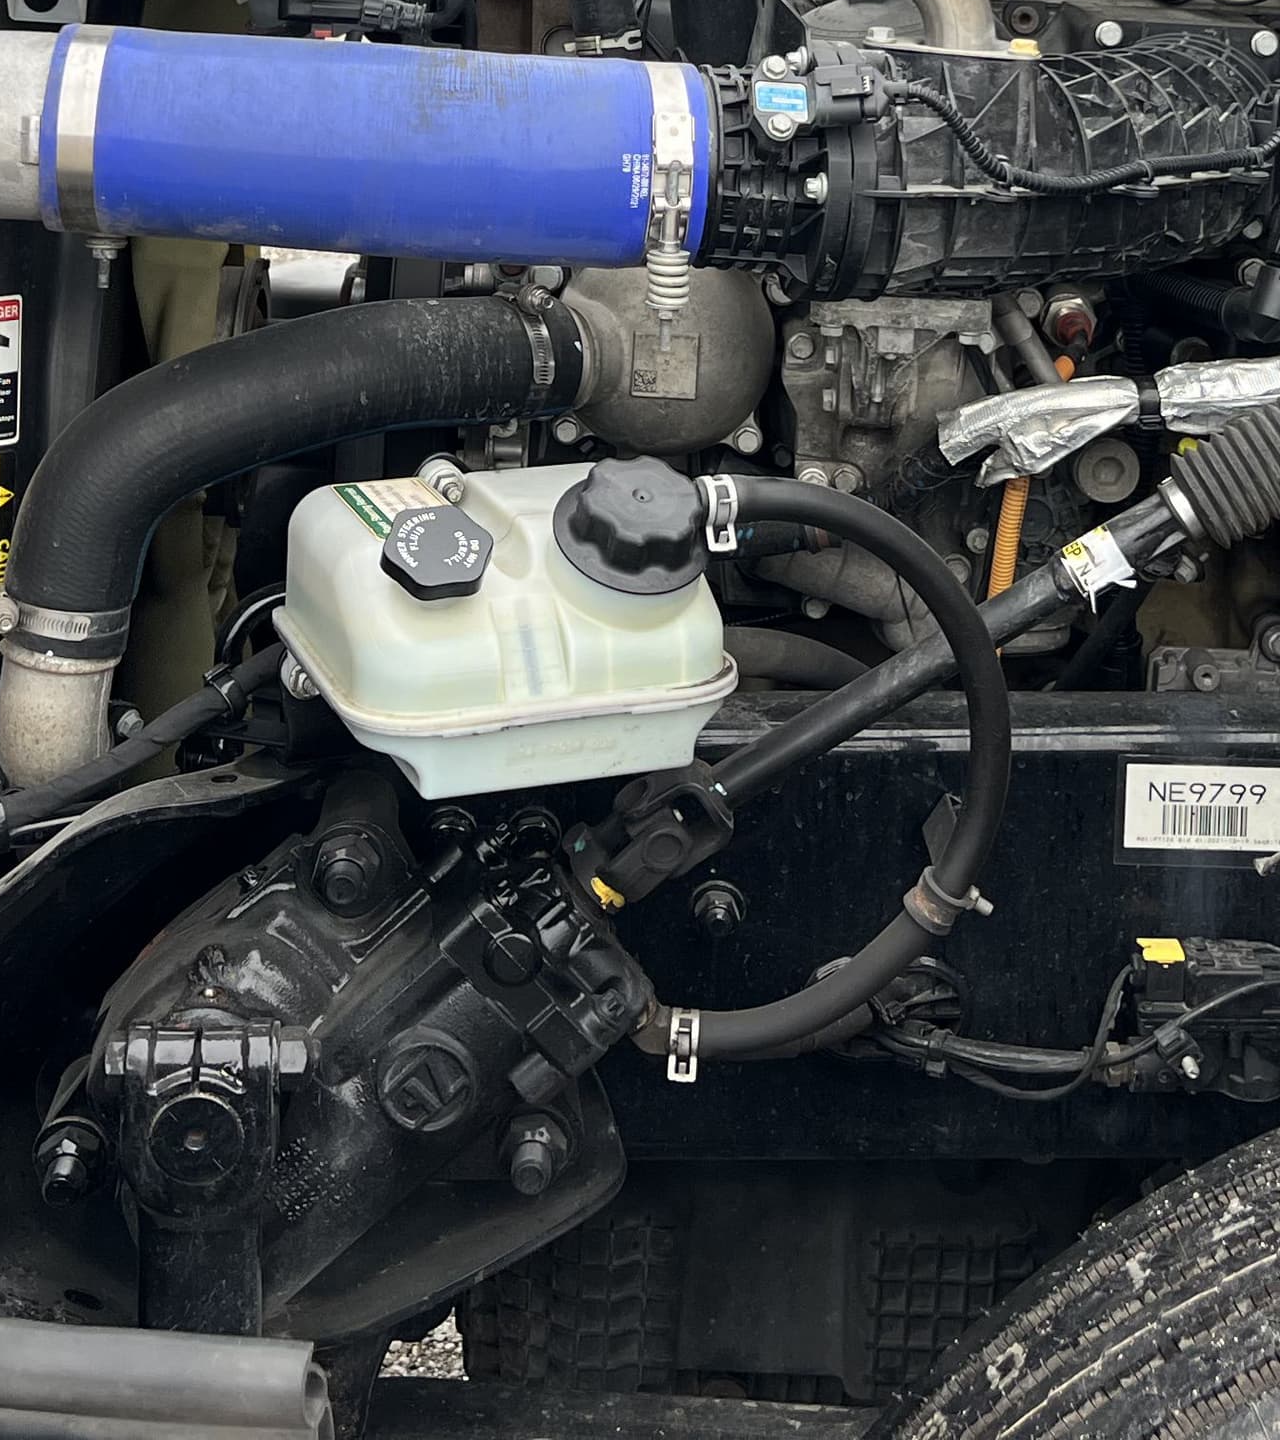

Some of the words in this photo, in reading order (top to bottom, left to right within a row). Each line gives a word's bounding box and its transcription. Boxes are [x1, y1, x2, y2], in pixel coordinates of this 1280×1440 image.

[632, 153, 641, 175] CHINA
[397, 512, 437, 538] STEERING
[409, 526, 425, 551] FLUID
[443, 530, 468, 566] OVERFILL
[470, 539, 480, 551] DO
[397, 541, 419, 568] POWER
[463, 553, 479, 568] NOT
[1148, 782, 1267, 804] NE9799
